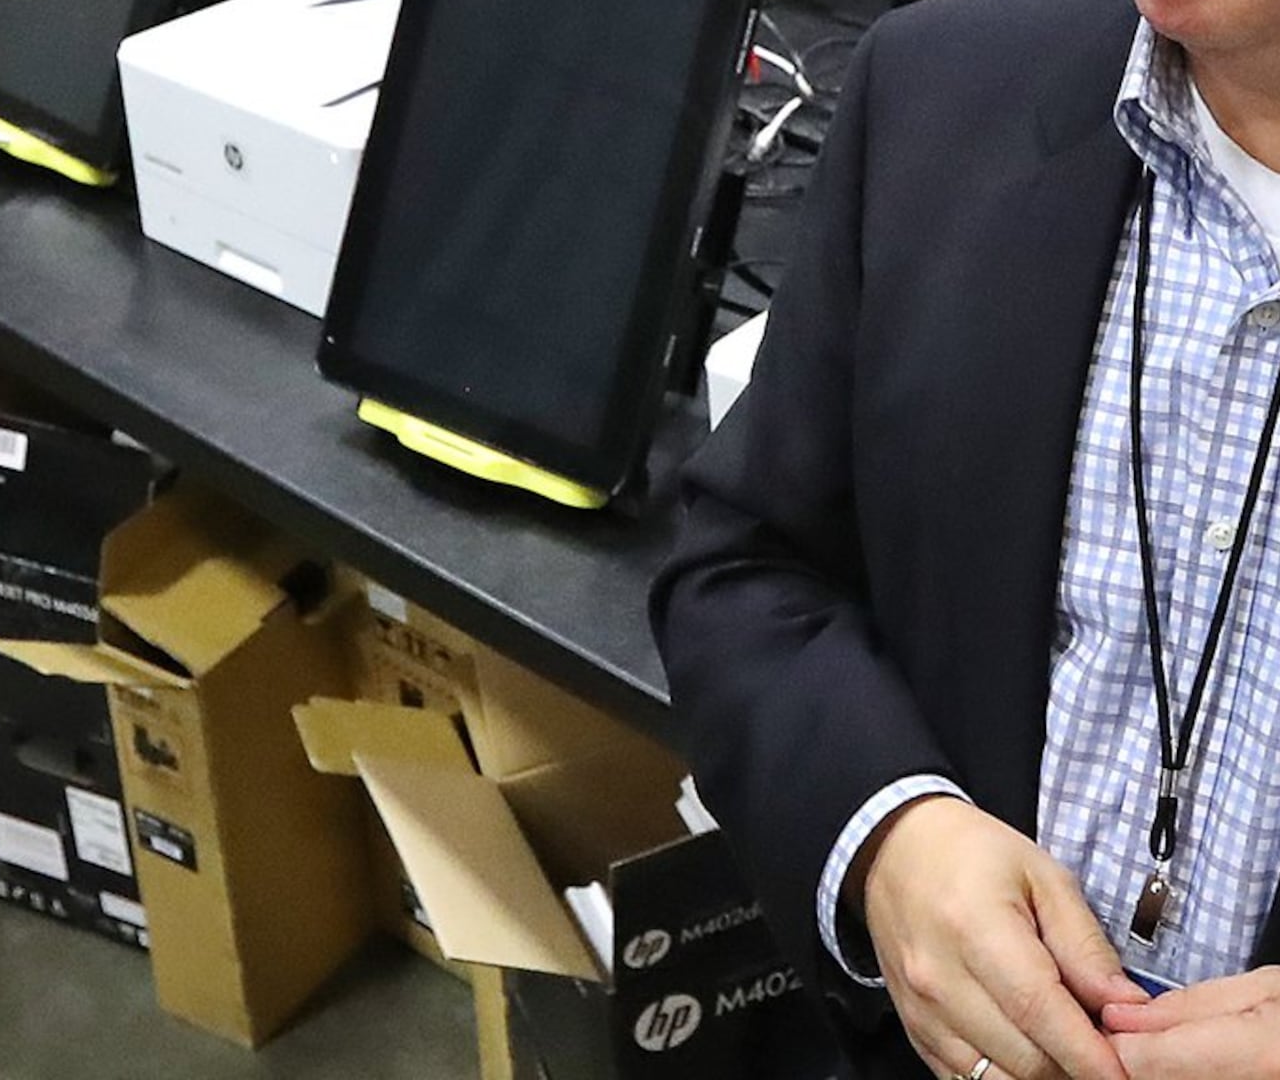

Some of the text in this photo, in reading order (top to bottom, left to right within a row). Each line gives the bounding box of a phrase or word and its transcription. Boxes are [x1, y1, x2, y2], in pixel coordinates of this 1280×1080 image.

[24, 588, 52, 610] PRO
[626, 929, 670, 968] hp
[638, 995, 699, 1051] hp
